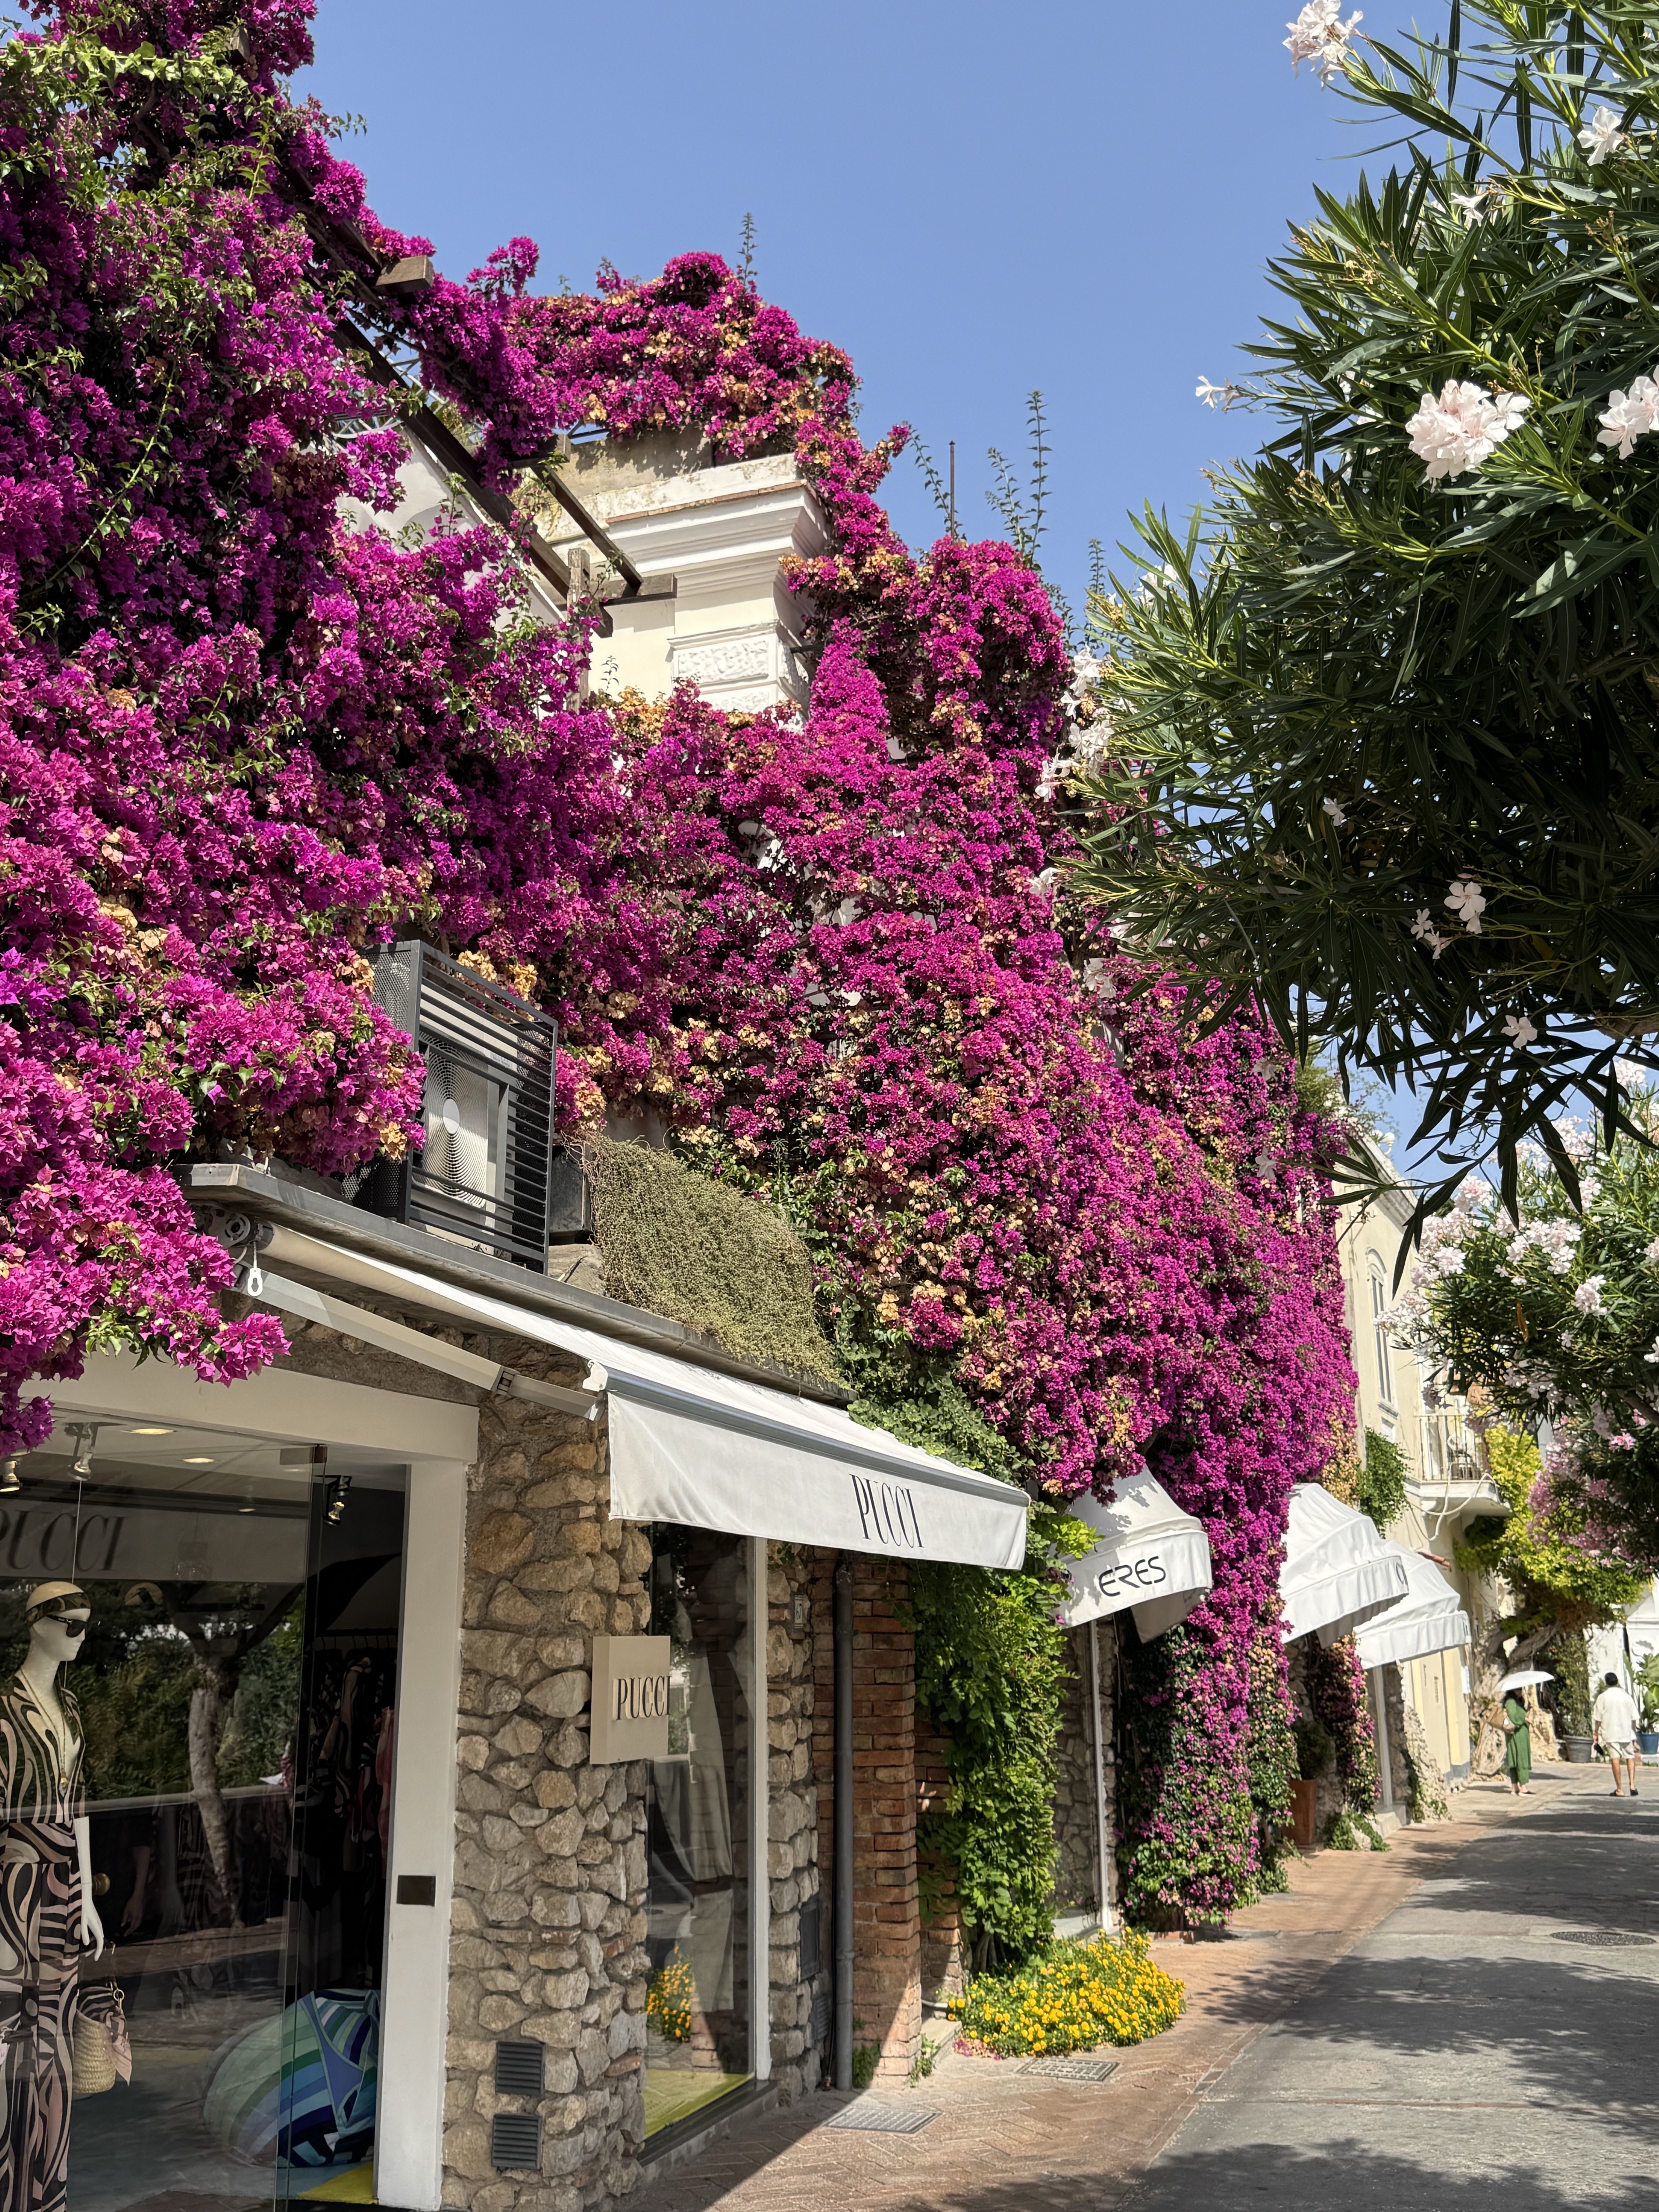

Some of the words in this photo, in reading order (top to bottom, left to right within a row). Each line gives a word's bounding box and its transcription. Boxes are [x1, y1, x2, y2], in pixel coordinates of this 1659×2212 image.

[849, 1474, 924, 1548] PUCCI
[0, 1509, 129, 1572] UCCI
[1098, 1556, 1166, 1597] ERES
[615, 1676, 672, 1721] PUCCI
